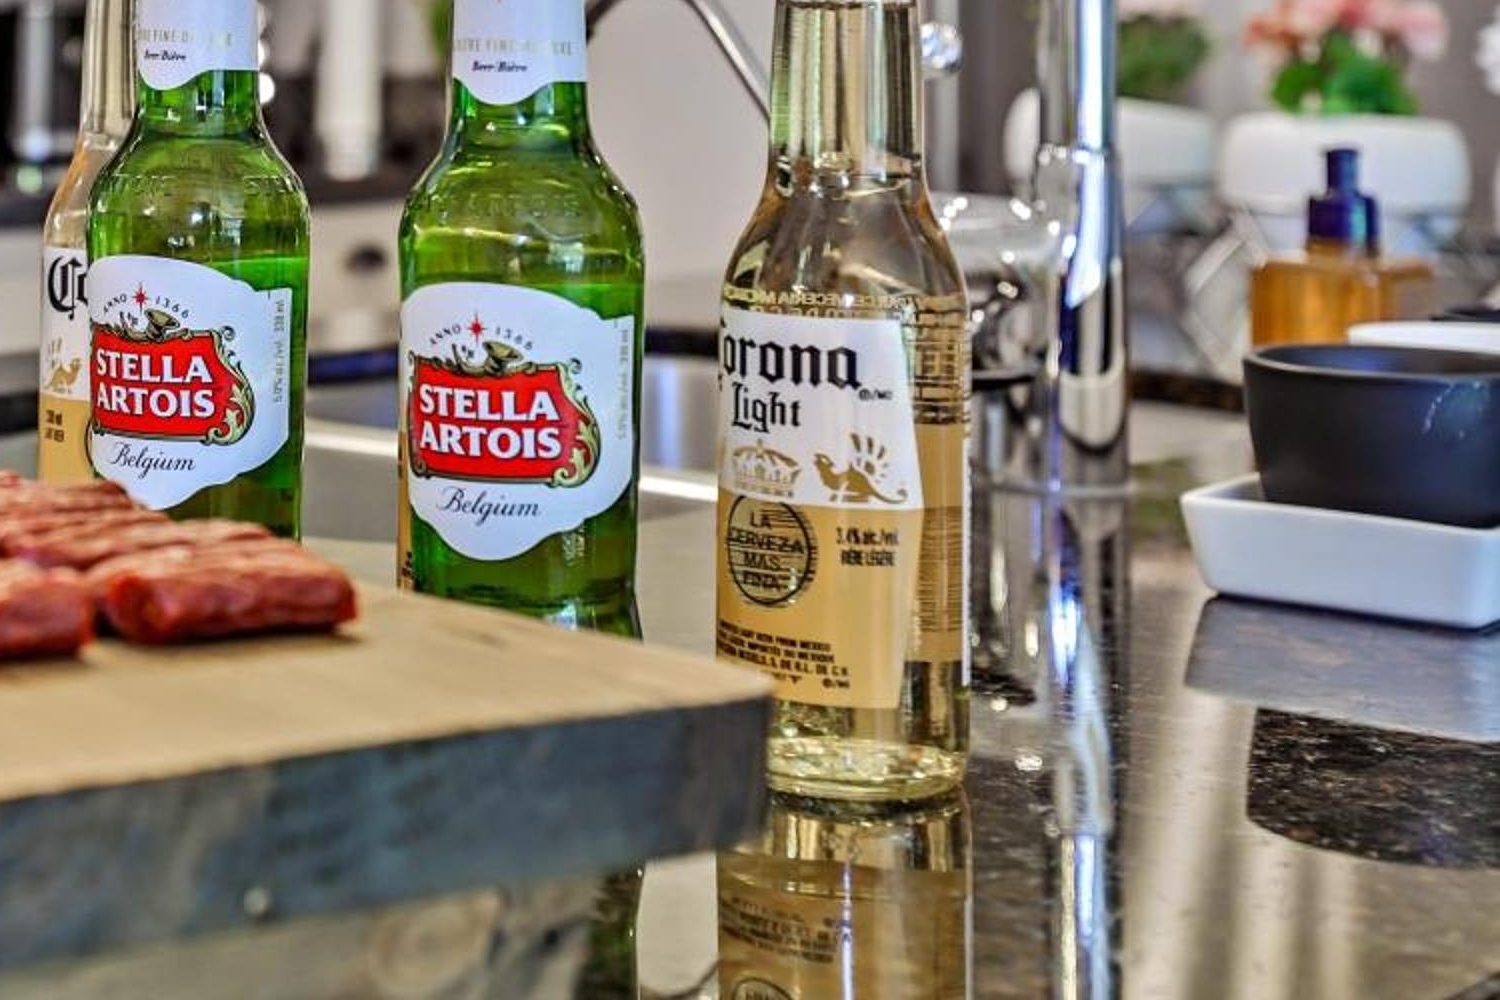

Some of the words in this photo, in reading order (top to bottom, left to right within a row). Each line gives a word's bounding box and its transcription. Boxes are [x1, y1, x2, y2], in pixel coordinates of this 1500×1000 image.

[95, 348, 214, 384] STELLA
[719, 328, 863, 391] orona
[96, 384, 216, 419] ARTOIS
[419, 383, 561, 422] STELLA
[731, 381, 801, 434] Light
[108, 440, 197, 480] Belgium
[419, 421, 562, 460] ARTOIS
[435, 485, 543, 527] Belgium
[749, 511, 771, 529] LA
[730, 526, 805, 554] CERVEZA
